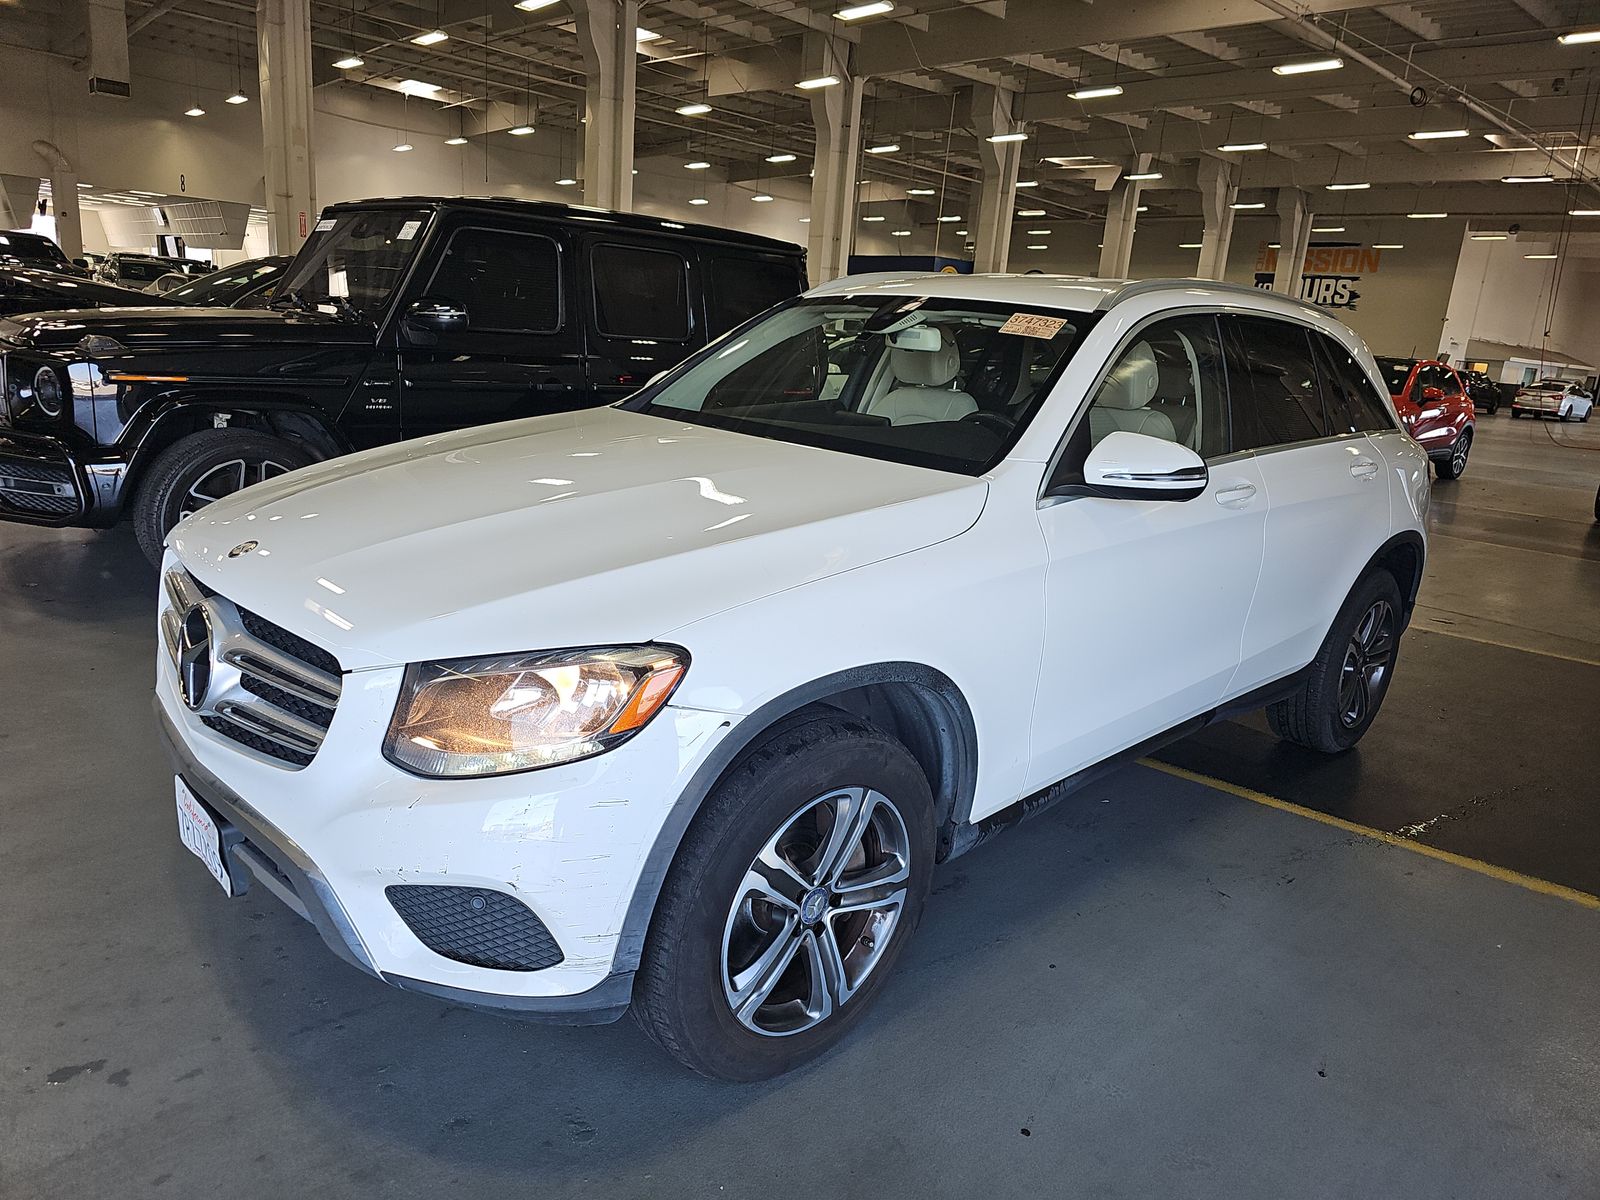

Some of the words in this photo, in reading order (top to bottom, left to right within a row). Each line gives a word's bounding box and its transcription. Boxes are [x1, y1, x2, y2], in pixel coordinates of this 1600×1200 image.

[180, 174, 186, 193] 8
[1264, 248, 1381, 273] MSSION
[1010, 315, 1064, 329] 3747323
